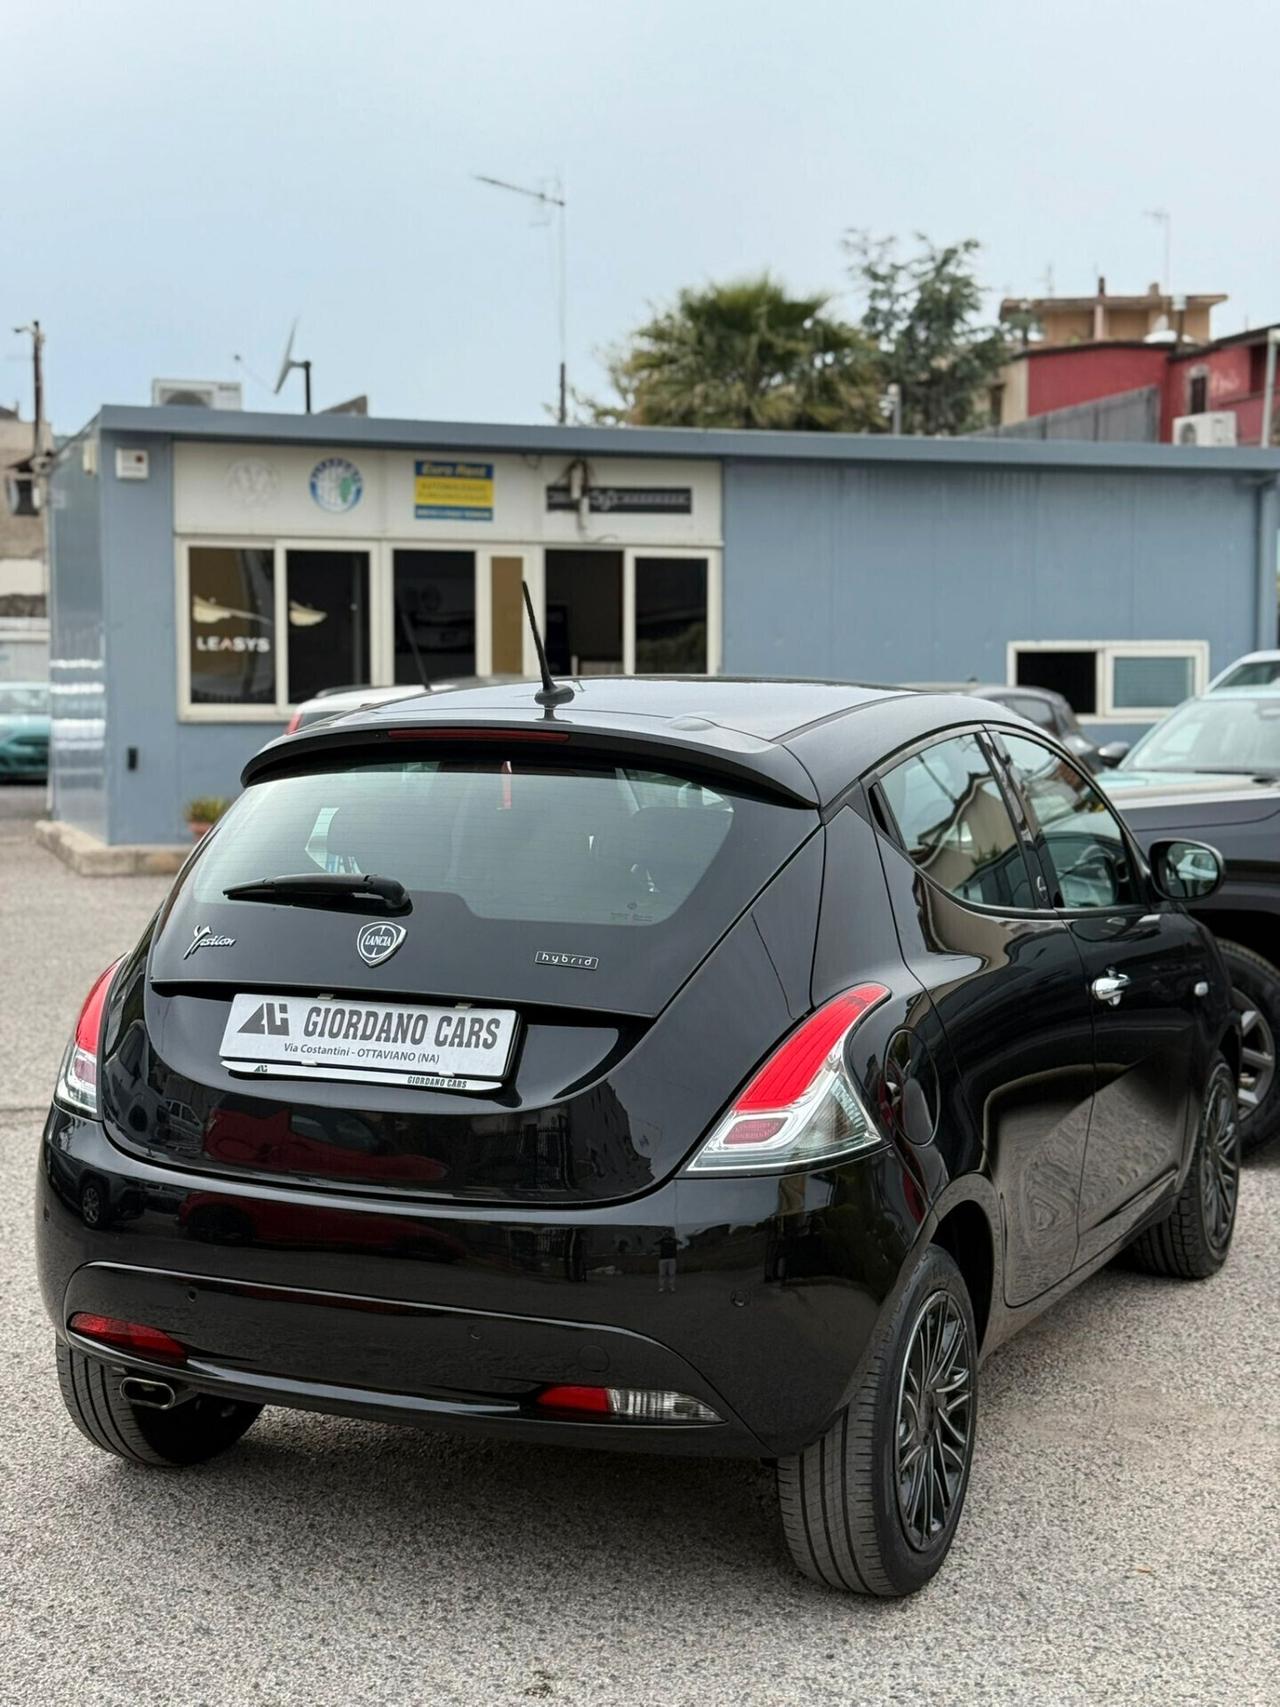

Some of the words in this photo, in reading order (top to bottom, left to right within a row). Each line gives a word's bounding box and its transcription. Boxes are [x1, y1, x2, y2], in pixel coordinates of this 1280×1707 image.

[196, 636, 270, 652] LEASYS
[183, 925, 236, 960] Ypsilon
[365, 935, 391, 947] LANCIA
[541, 953, 592, 967] hybrid
[303, 1006, 428, 1044] GIORDANO
[434, 1015, 501, 1050] CARS
[284, 1042, 299, 1053] Via
[300, 1043, 350, 1057] Costantini
[357, 1049, 416, 1063] OTTAVIANO
[417, 1052, 440, 1065] (NA)
[407, 1075, 446, 1088] GIORDANO
[446, 1078, 468, 1089] CARS
